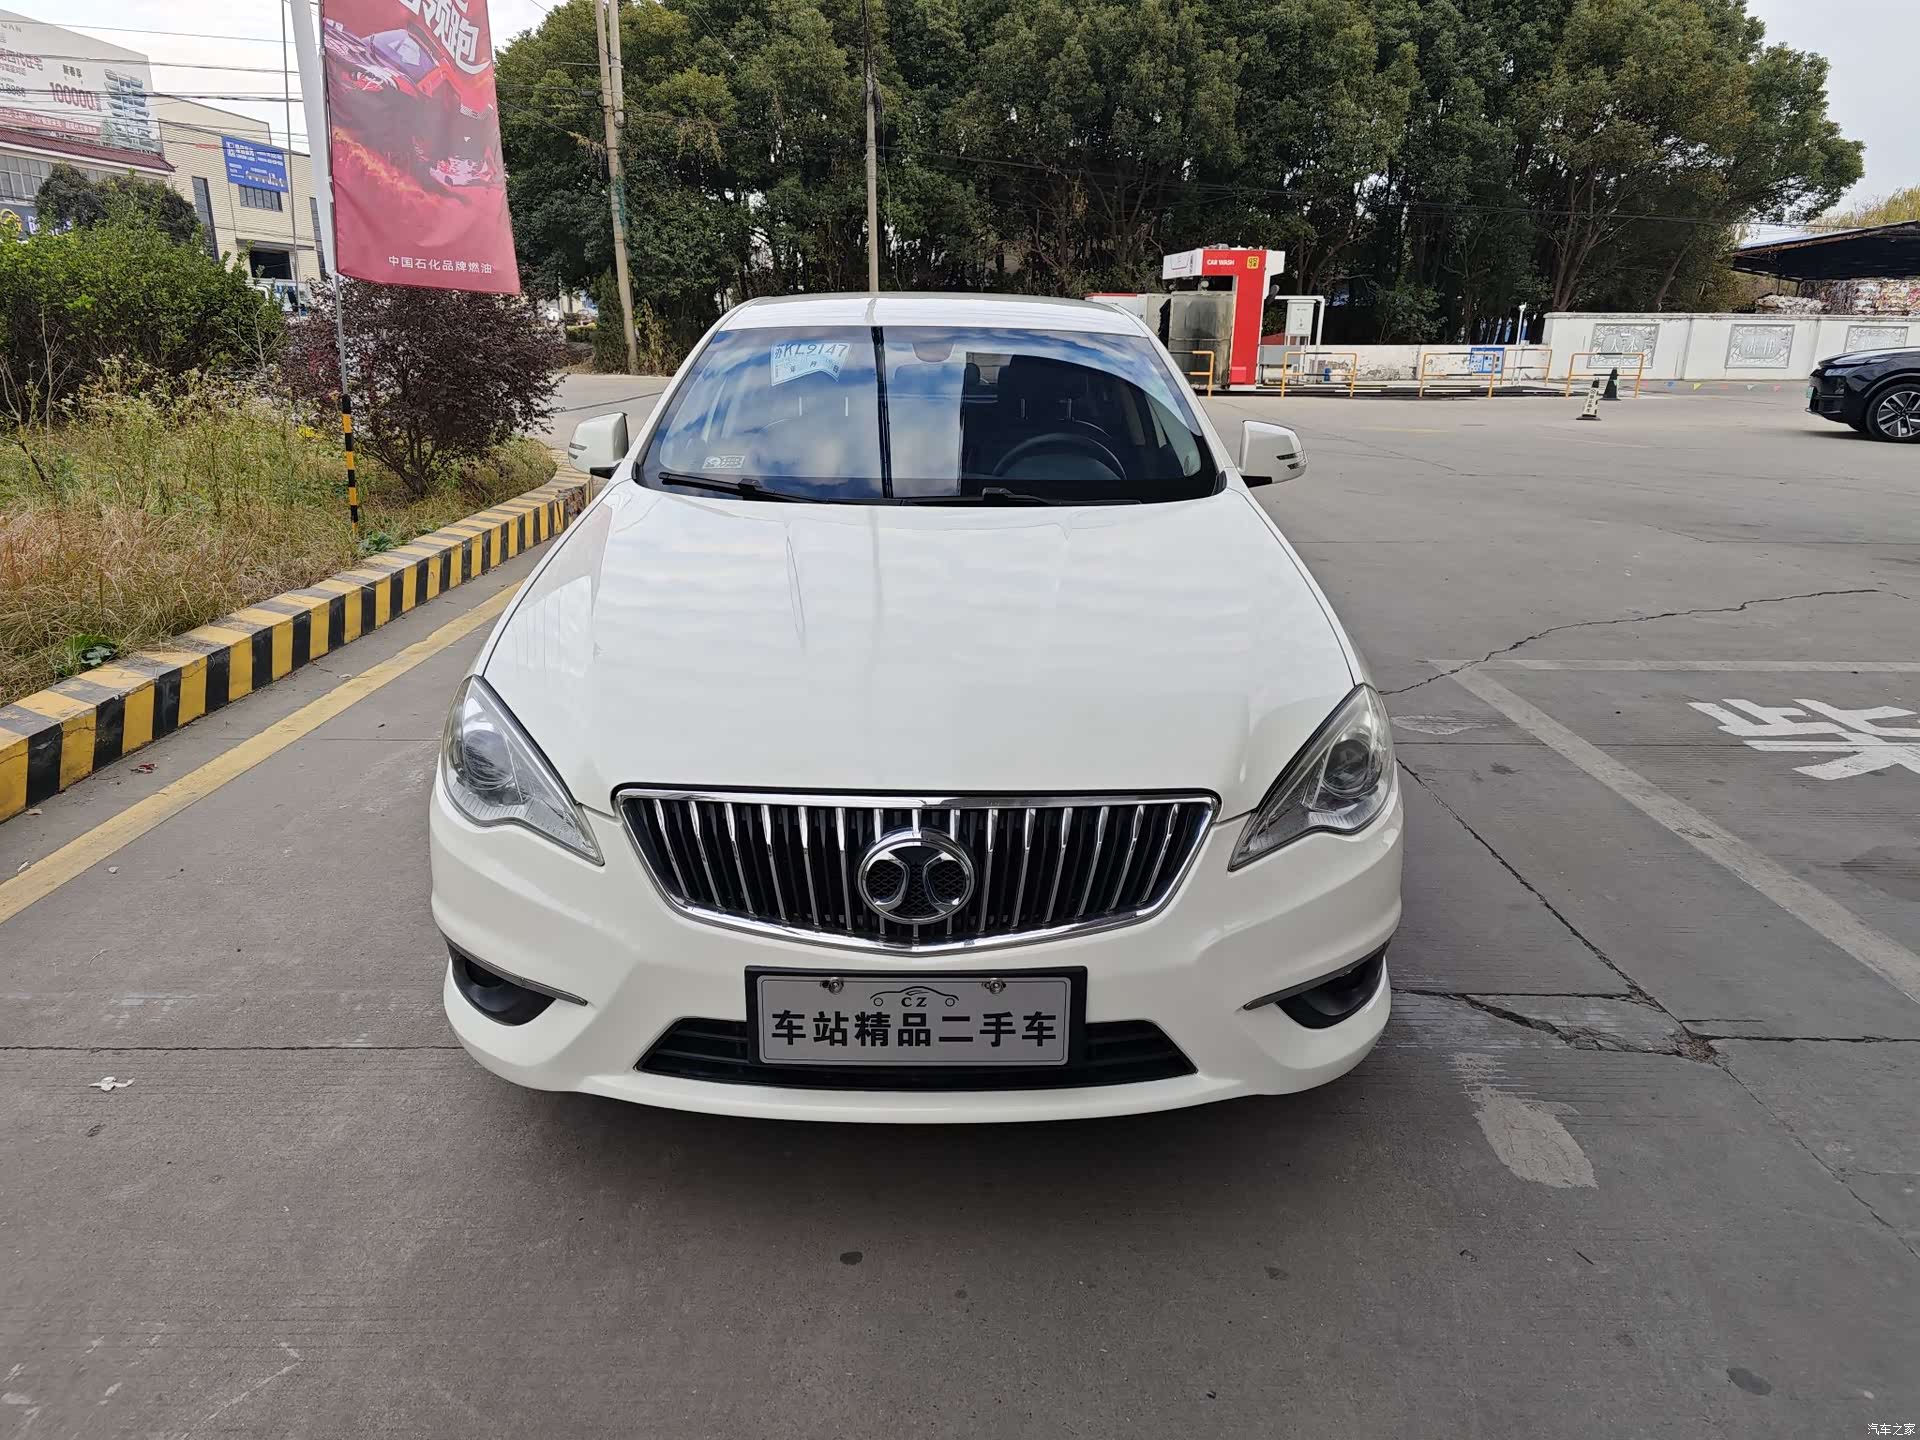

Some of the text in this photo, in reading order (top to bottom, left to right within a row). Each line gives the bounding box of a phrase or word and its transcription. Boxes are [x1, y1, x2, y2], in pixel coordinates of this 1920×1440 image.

[388, 255, 492, 274] 中国石化品牌燃油
[901, 997, 927, 1008] CZ
[770, 1009, 1057, 1048] 车站精品二手车
